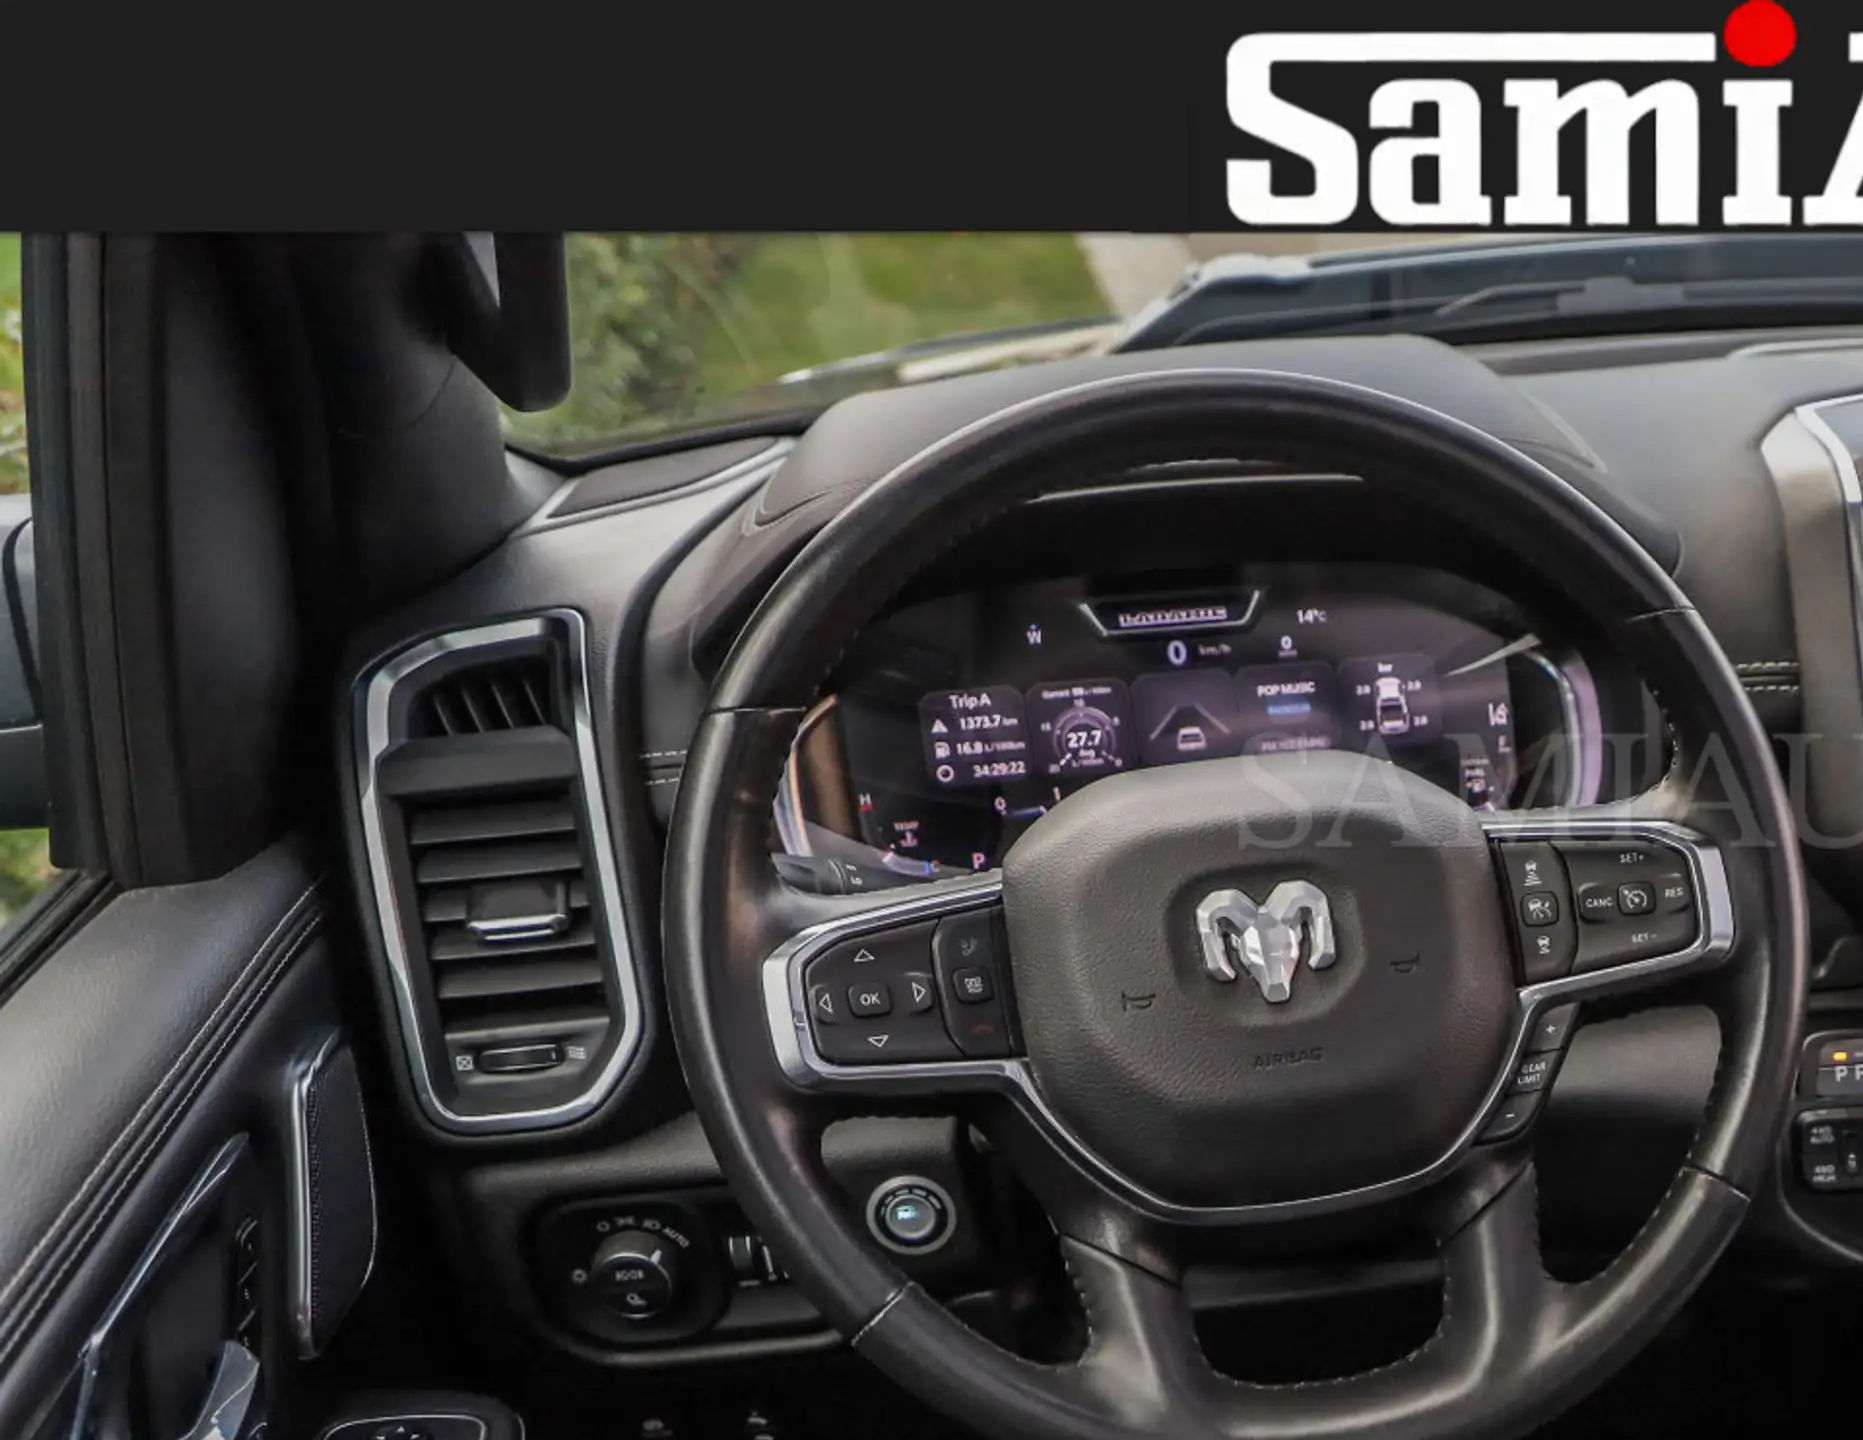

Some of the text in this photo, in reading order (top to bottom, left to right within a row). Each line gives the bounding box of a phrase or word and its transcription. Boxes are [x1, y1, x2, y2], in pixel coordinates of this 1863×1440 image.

[1166, 640, 1188, 666] 0
[949, 693, 993, 711] Trip A
[960, 714, 1002, 731] 1373.7
[1066, 730, 1103, 749] 27.7
[971, 852, 986, 870] P
[1664, 887, 1684, 899] RES
[1585, 896, 1613, 909] CANC
[860, 991, 882, 1007] OK
[1253, 1047, 1324, 1071] AIRBAG
[1834, 1066, 1848, 1082] P
